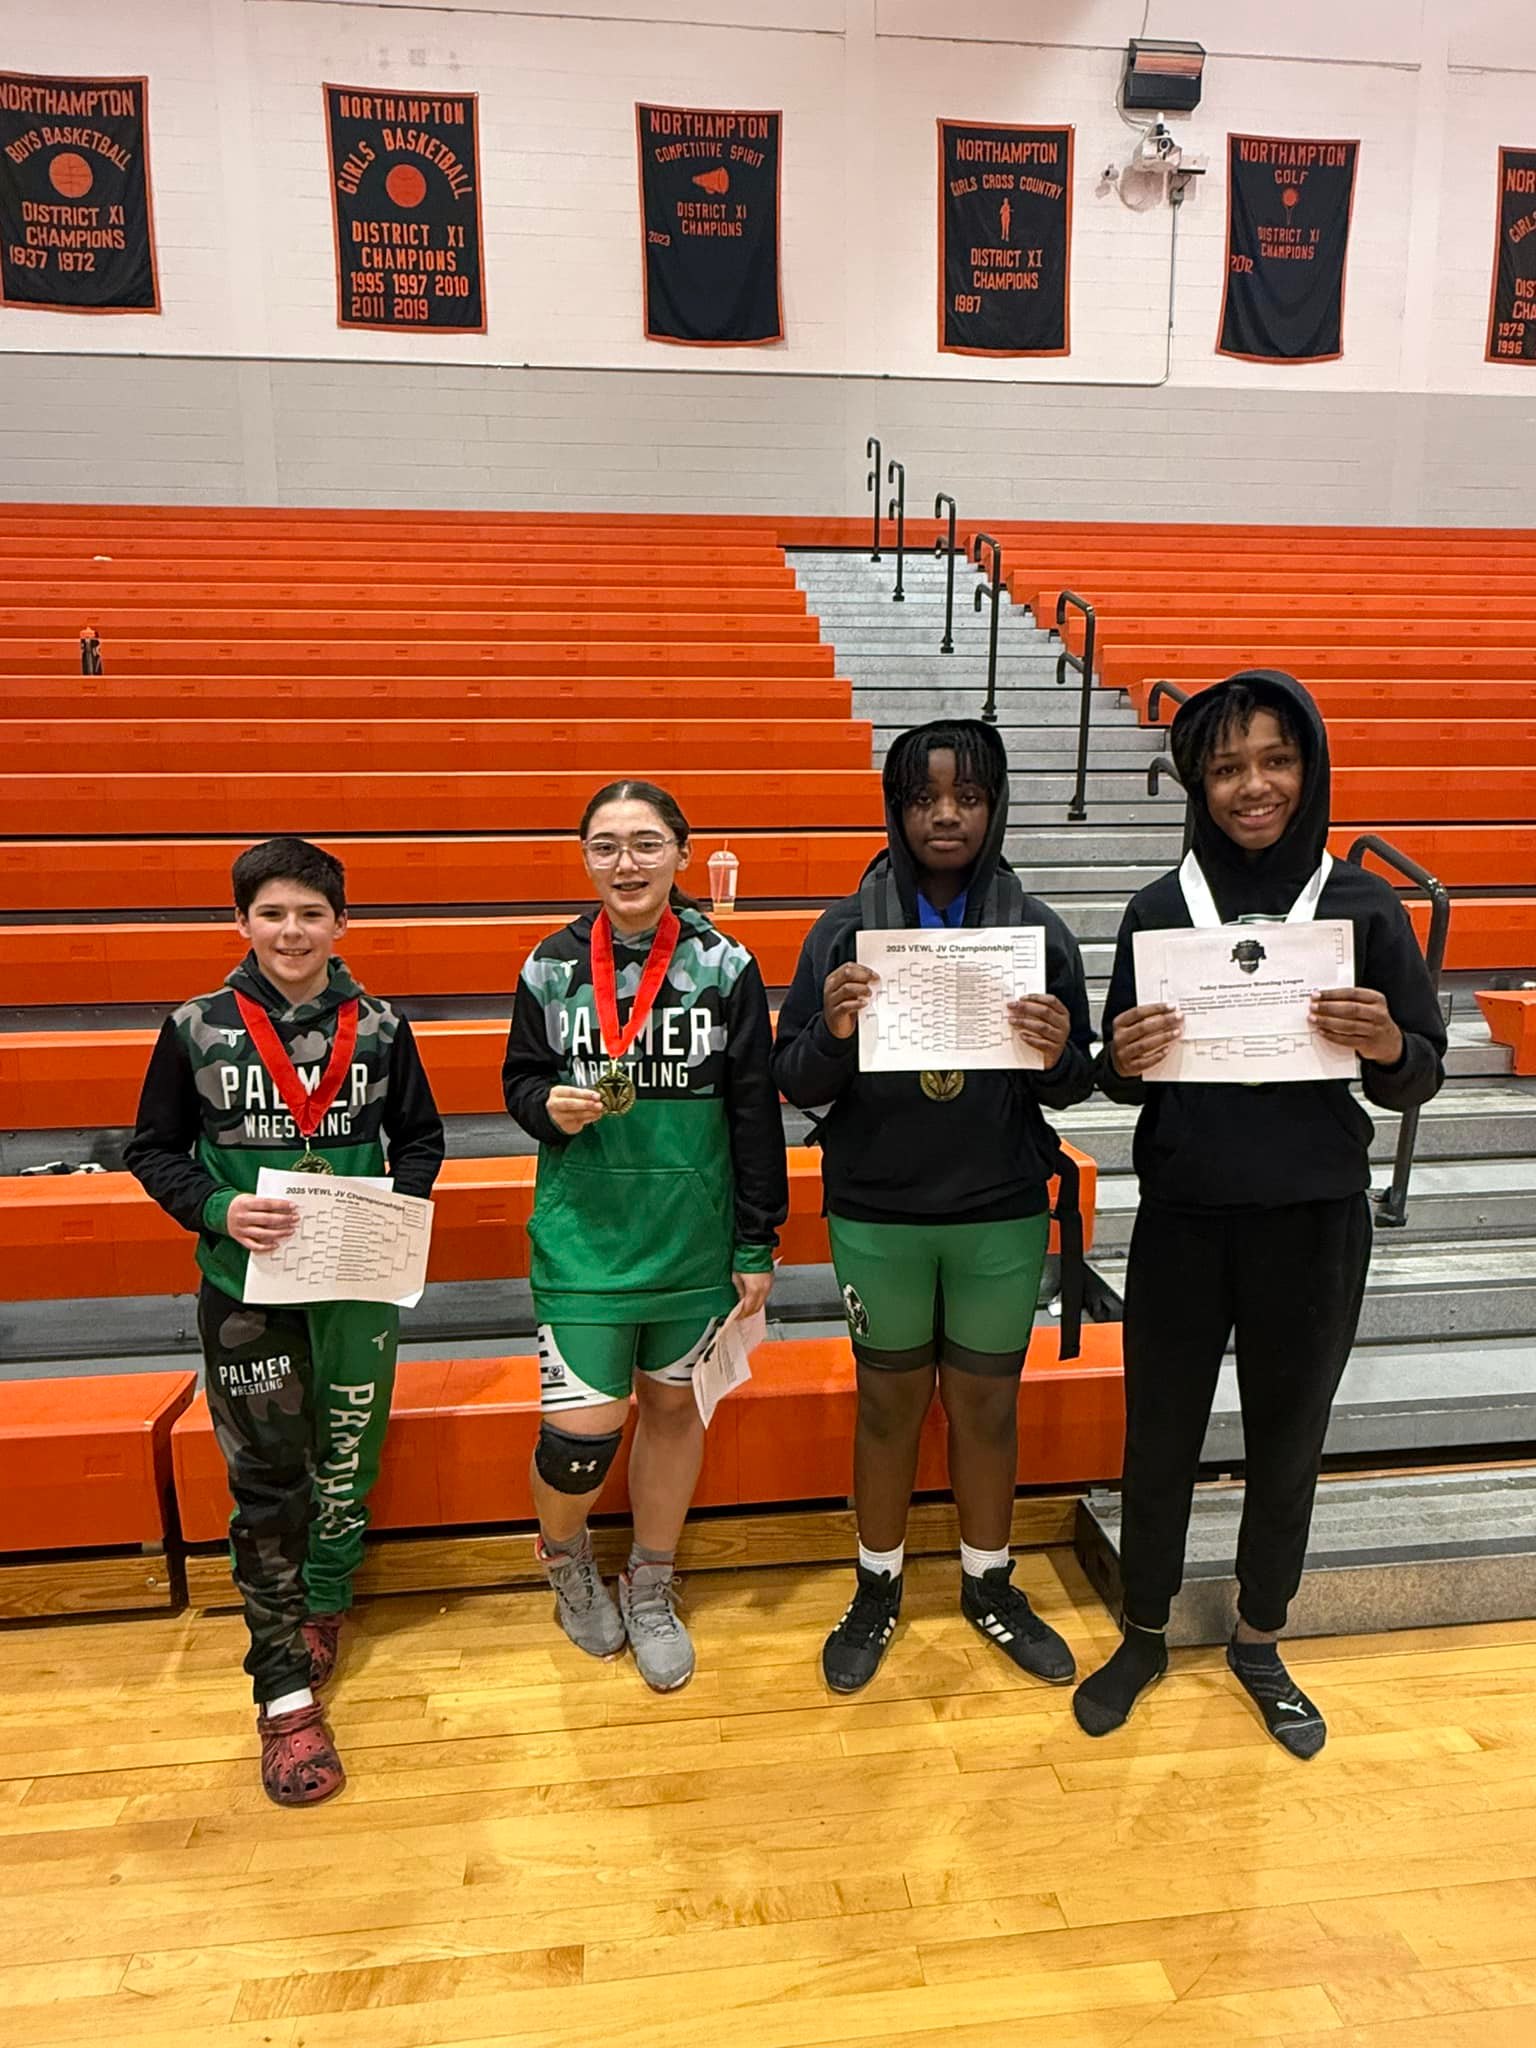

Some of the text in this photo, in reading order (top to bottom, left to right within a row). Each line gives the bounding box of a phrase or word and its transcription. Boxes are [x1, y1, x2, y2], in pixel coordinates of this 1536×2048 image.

[0, 83, 135, 117] NORTHAMPTON
[339, 95, 465, 125] NORTHAMPTON
[650, 110, 768, 139] NORTHAMPTON
[5, 126, 132, 171] BOYS BASKETBALL
[655, 141, 765, 168] COMPETITIVE SPIRIT
[956, 138, 1058, 164] NORTHAMPTON
[1240, 140, 1346, 167] NORTHAMPTON
[337, 127, 473, 200] GIRLS BASKETBALL
[1274, 169, 1309, 184] GOLF
[950, 174, 1064, 200] GIRLS CROSS COUNTRY
[22, 201, 125, 227] DISTRICT XI
[676, 201, 747, 220] DISTRICT XI
[26, 226, 126, 249] CHAMPIONS
[351, 220, 465, 248] DISTRICT XI
[681, 220, 743, 237] CHAMPIONS
[1257, 226, 1320, 243] DISTRICT XI
[9, 244, 96, 272] 1937 1972
[361, 246, 457, 272] CHAMPIONS
[970, 248, 1043, 268] DISTRICT XI
[1261, 243, 1314, 260] CHAMPIONS
[350, 271, 469, 297] 1995 1997 2010
[973, 270, 1039, 290] CHAMPIONS
[351, 296, 429, 320] 2011 2019
[954, 294, 981, 314] 1987
[1498, 322, 1525, 337] 1979
[1497, 340, 1523, 355] 1996
[908, 944, 934, 953] VEWL
[936, 944, 947, 953] JV
[949, 943, 1014, 954] Championships
[220, 1063, 368, 1110] PALMR
[572, 1060, 689, 1088] WRETLING
[244, 1112, 352, 1138] WRESING
[307, 1187, 332, 1197] VEWL
[333, 1189, 346, 1198] JV
[218, 1354, 292, 1386] PALMER
[229, 1377, 284, 1397] WRESTLING
